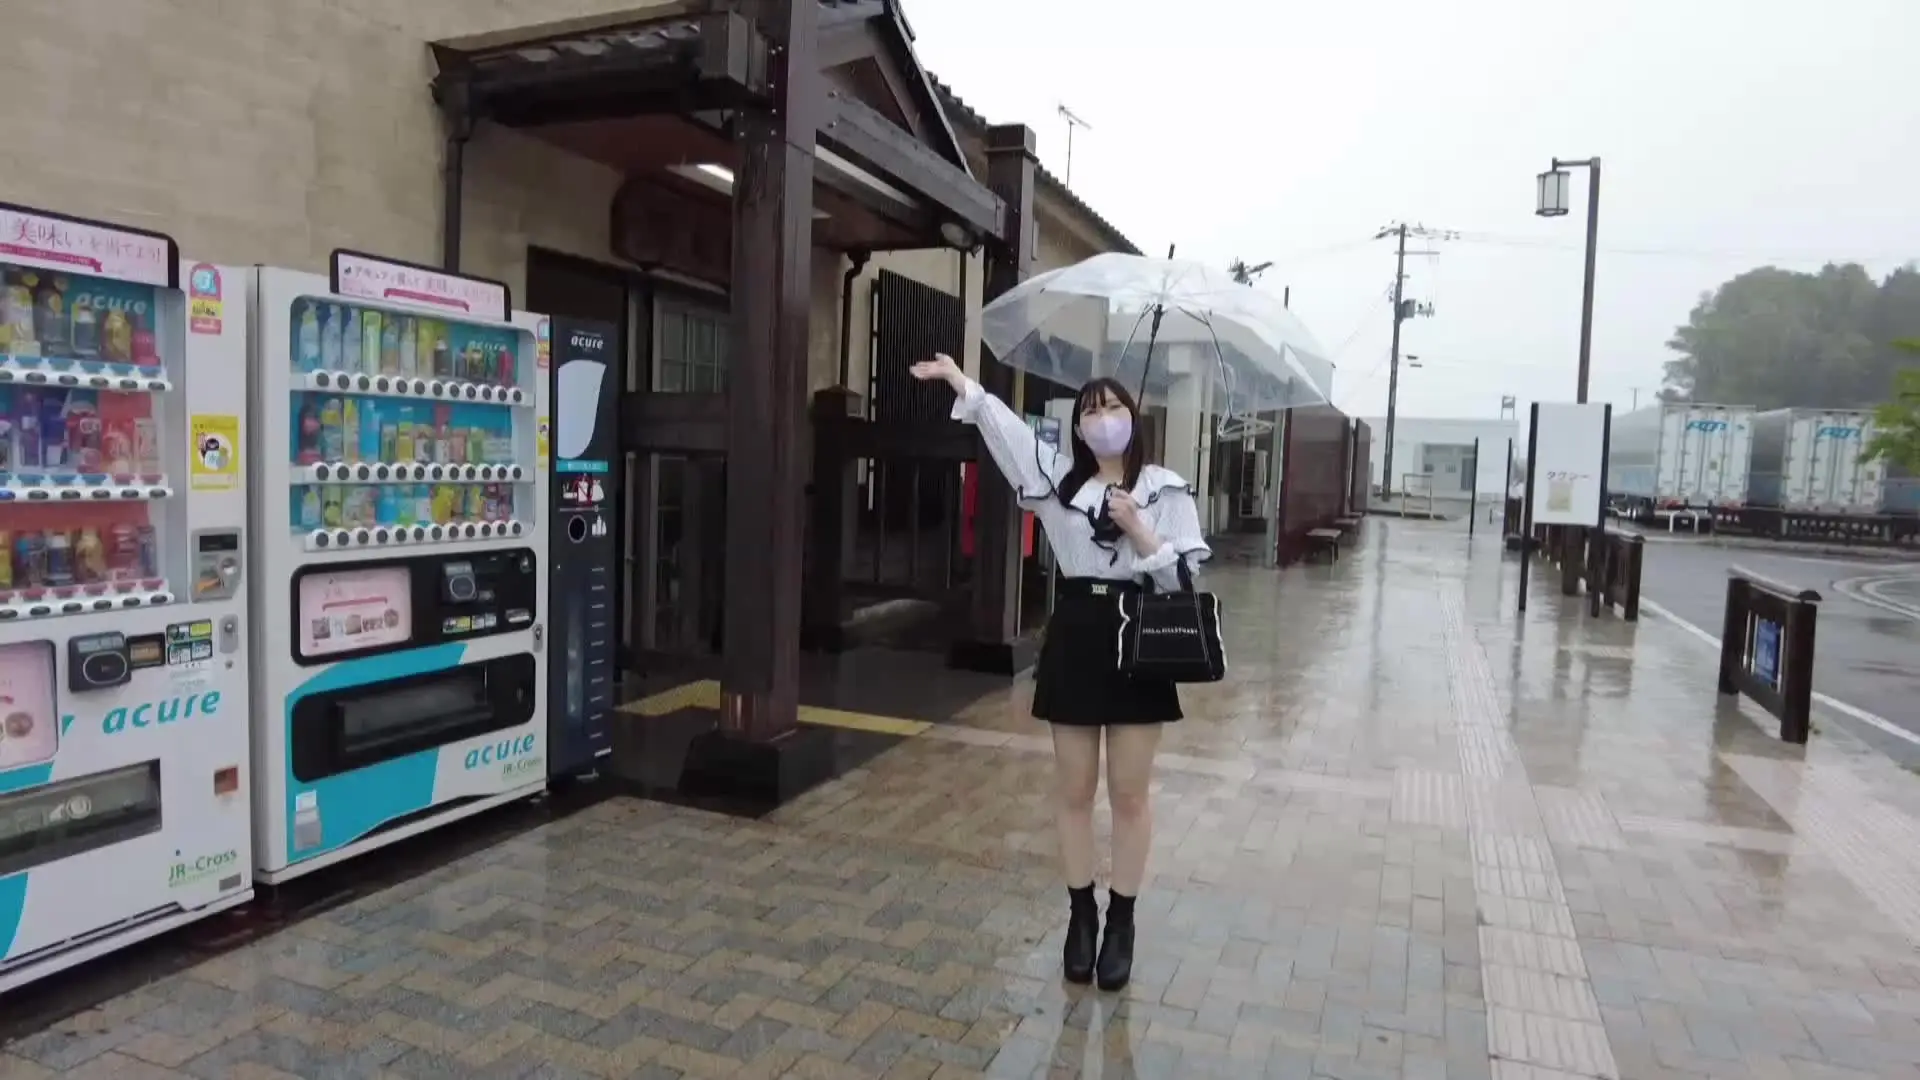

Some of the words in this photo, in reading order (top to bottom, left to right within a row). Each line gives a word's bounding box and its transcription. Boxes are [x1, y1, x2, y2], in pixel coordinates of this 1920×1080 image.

[76, 291, 148, 315] acure
[571, 335, 605, 350] acure
[102, 690, 221, 734] acure
[464, 733, 535, 770] acure
